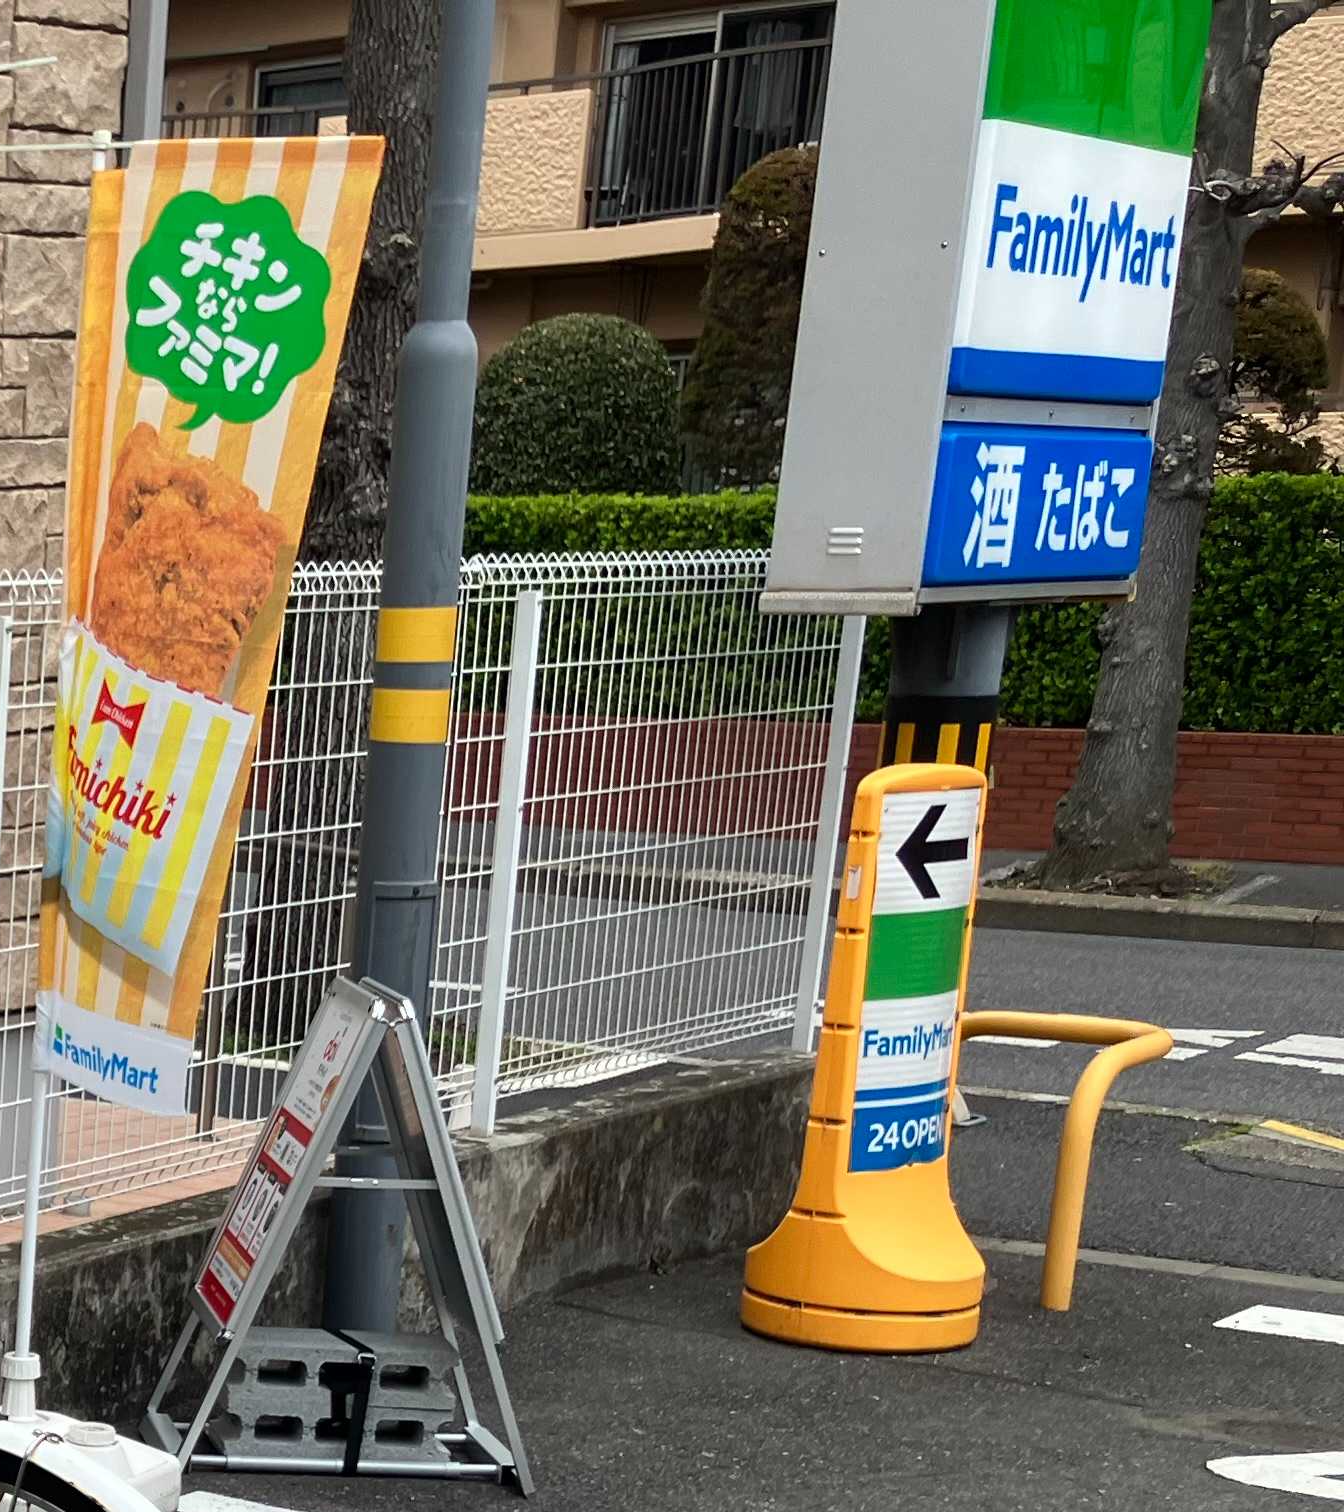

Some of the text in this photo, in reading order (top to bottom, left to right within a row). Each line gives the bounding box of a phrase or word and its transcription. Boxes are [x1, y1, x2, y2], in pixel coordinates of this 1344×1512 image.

[180, 223, 302, 313] チキン
[986, 183, 1176, 303] FamilyMart
[195, 279, 247, 332] なら
[963, 441, 1135, 569] 酒 たばこ
[65, 1033, 159, 1094] FamilyMart
